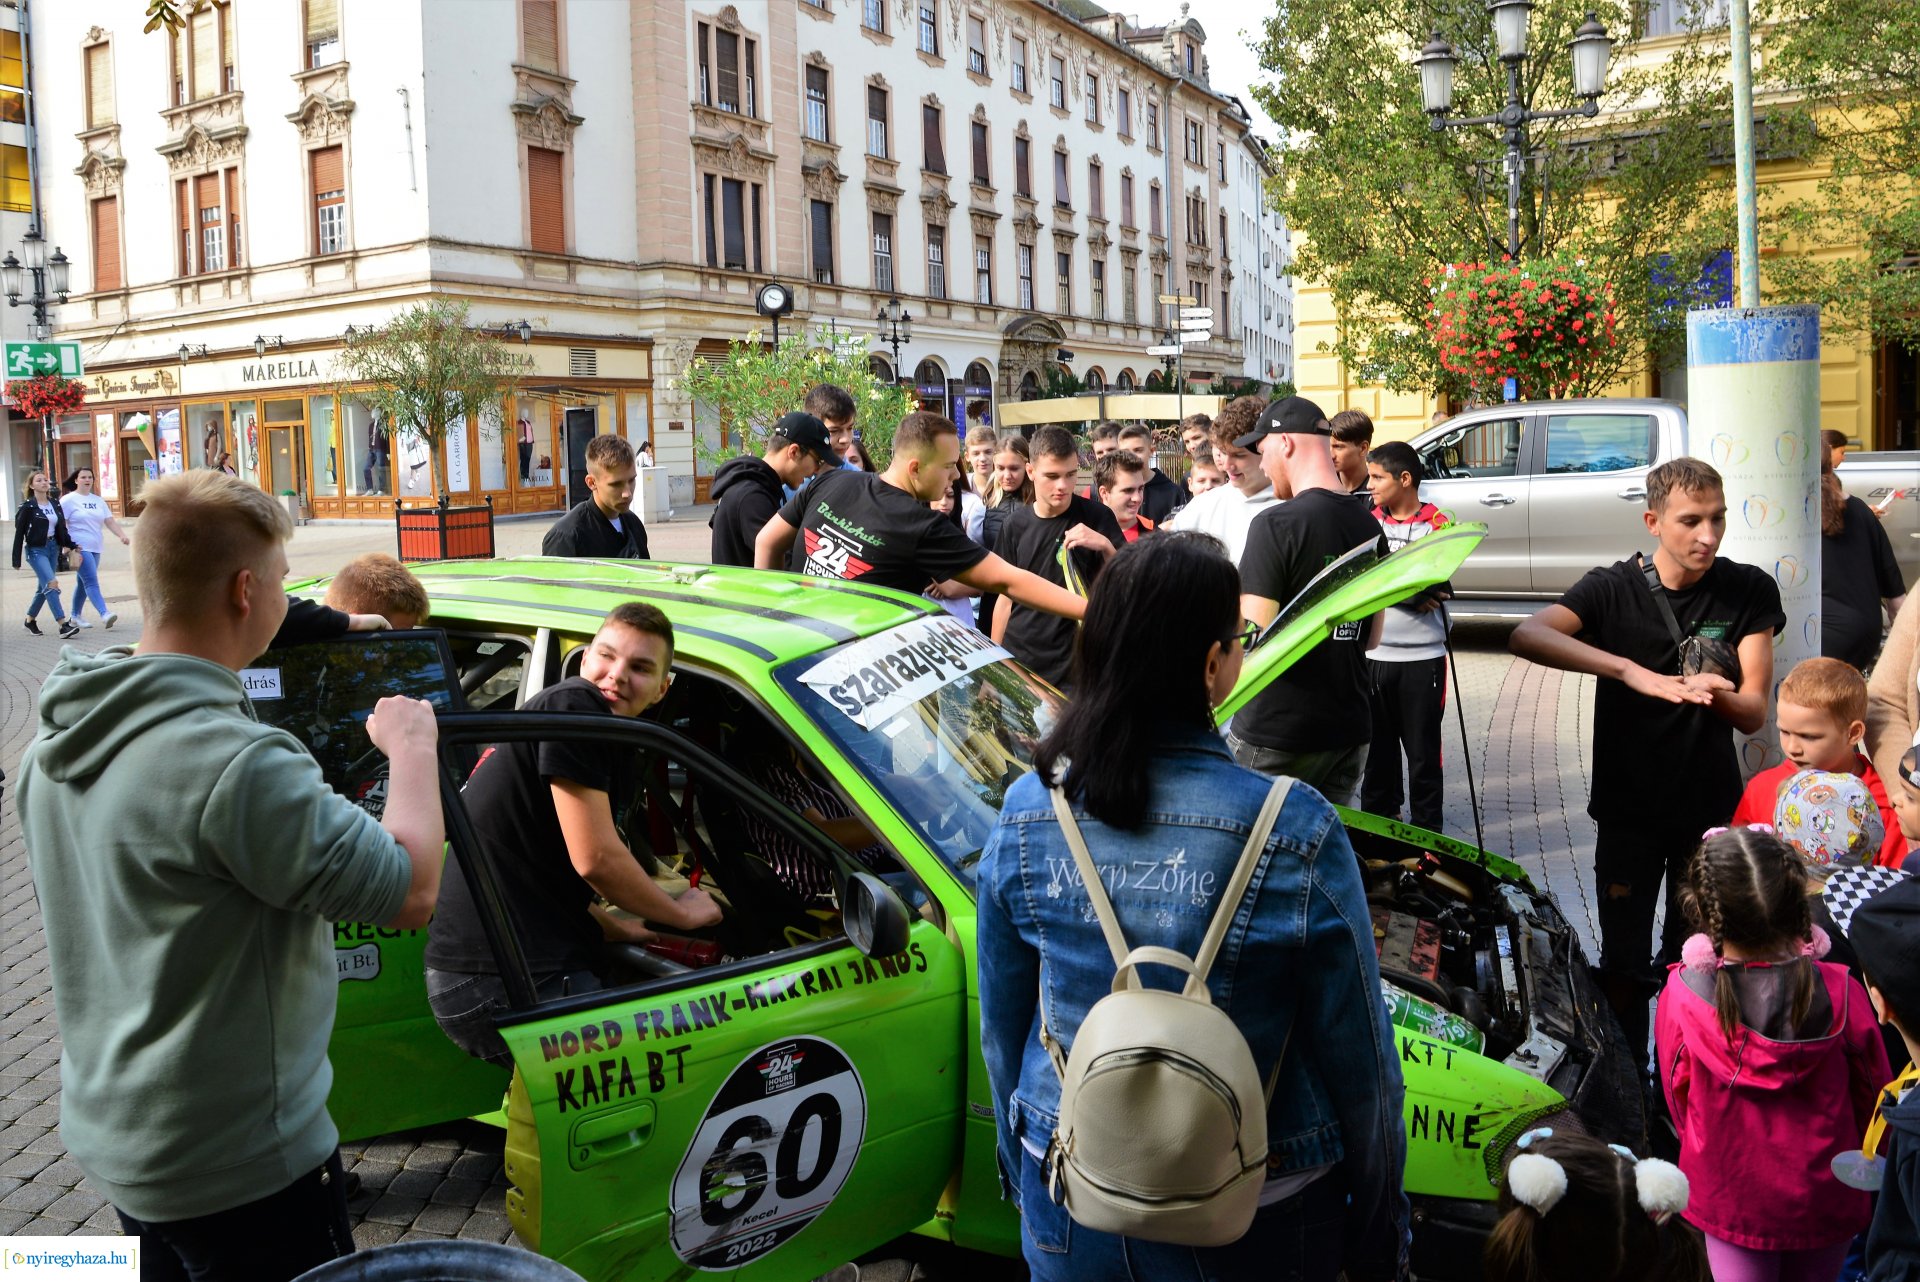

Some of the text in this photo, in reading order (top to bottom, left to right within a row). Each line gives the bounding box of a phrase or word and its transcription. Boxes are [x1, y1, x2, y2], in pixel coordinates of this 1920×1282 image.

[243, 360, 318, 382] MARELLA
[811, 537, 850, 576] 24
[243, 675, 276, 690] drás
[1133, 860, 1216, 897] Zone
[353, 954, 375, 969] Bt.
[539, 1020, 623, 1063] NORD
[768, 1072, 794, 1086] HOURS
[769, 1054, 794, 1079] 24
[555, 1056, 637, 1113] KAFA
[1411, 1103, 1483, 1149] NNÉ
[699, 1092, 842, 1227] 60
[741, 1205, 778, 1227] Kecel
[725, 1231, 778, 1263] 2022
